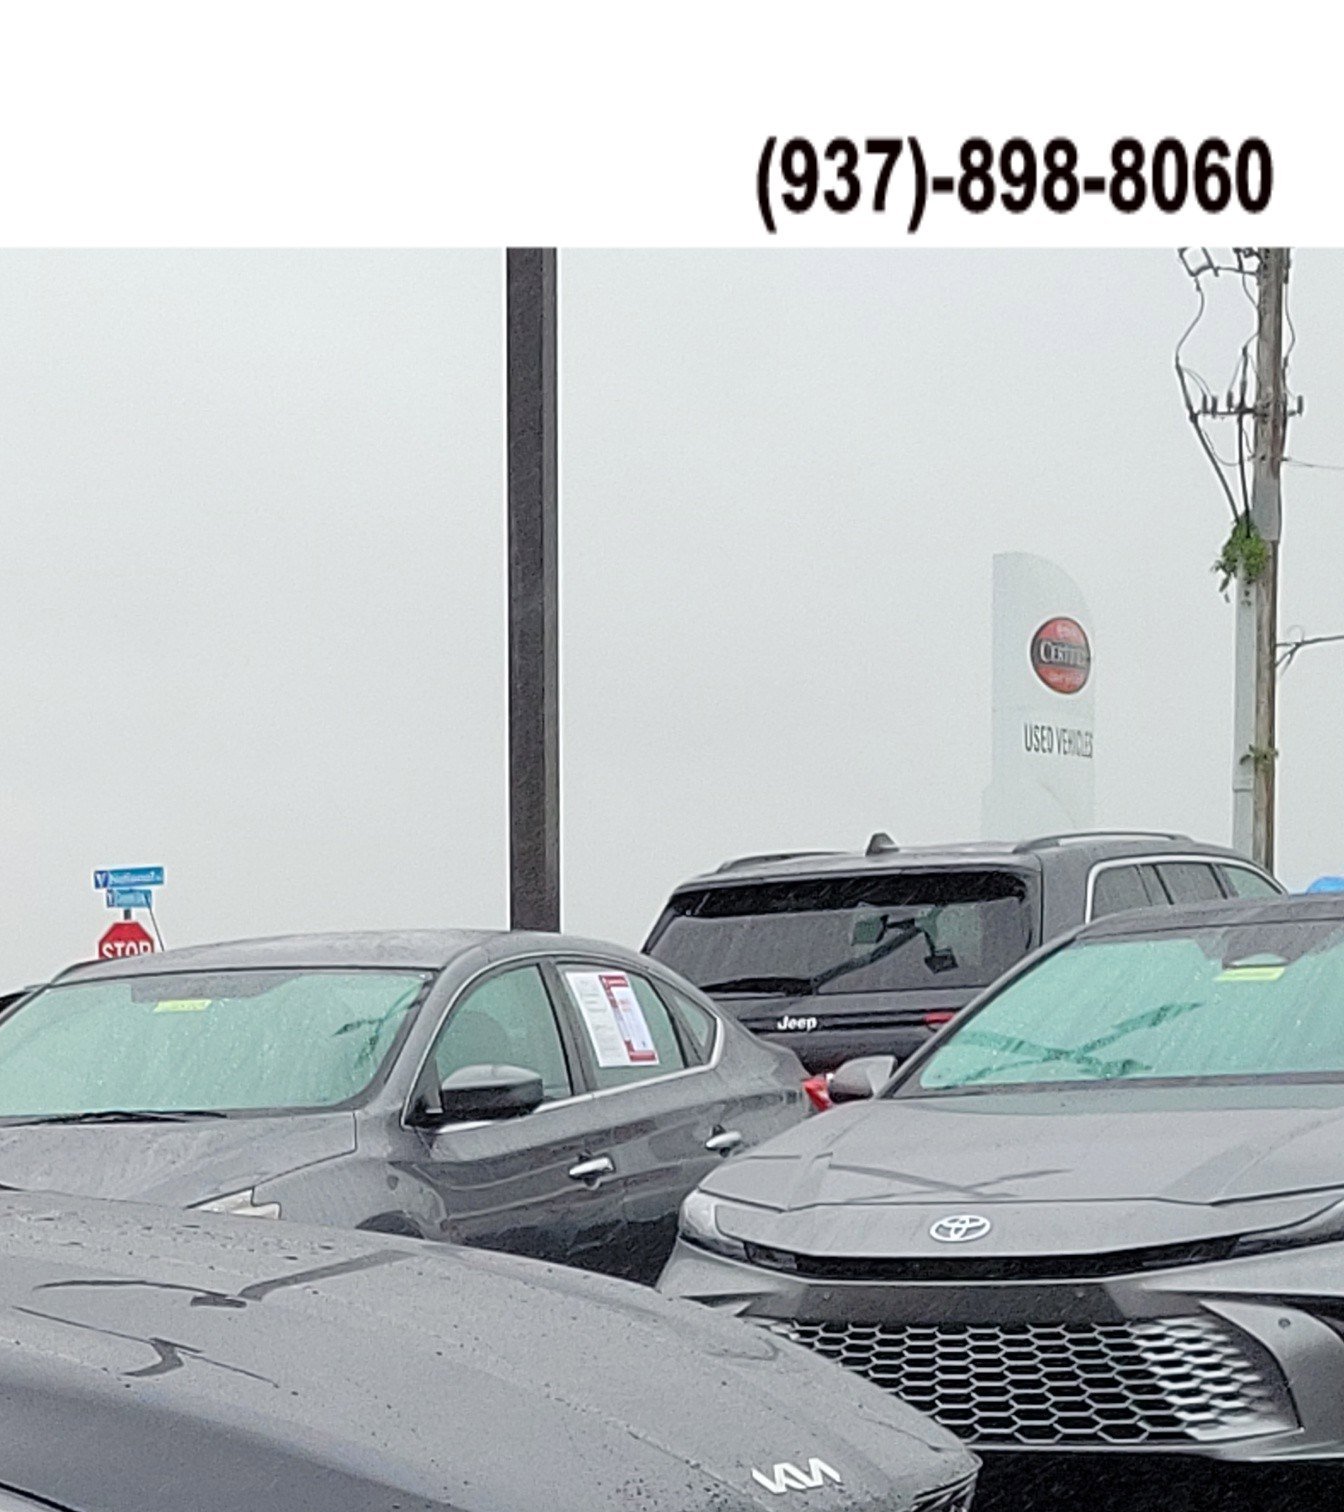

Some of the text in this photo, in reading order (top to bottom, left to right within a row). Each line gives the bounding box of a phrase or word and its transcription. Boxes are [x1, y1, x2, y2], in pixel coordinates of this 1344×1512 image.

[1023, 722, 1054, 754] USED
[102, 941, 152, 958] STOP
[777, 1015, 818, 1032] Jeep
[752, 1458, 841, 1494] KIA
